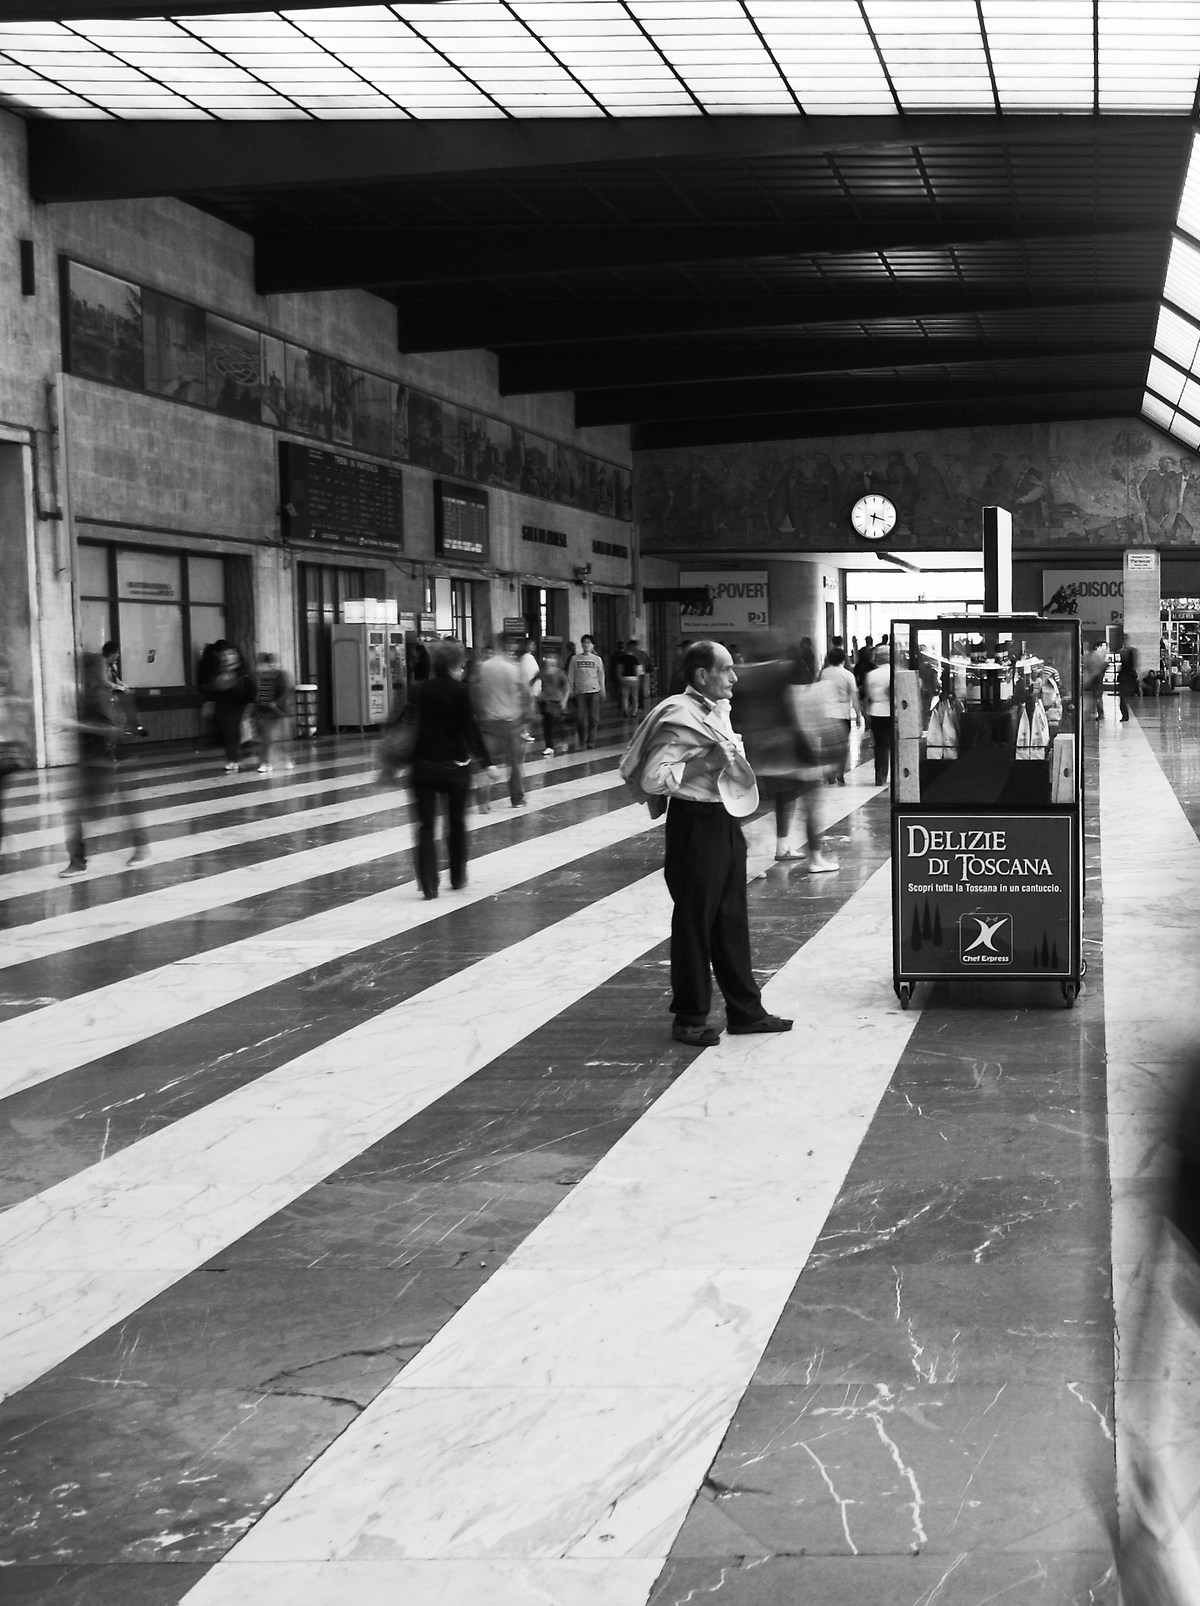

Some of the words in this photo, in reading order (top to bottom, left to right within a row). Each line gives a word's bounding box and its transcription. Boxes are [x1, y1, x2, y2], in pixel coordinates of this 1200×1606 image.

[907, 825, 1007, 857] DELIZIE
[928, 858, 949, 875] DI
[954, 854, 1053, 881] TOSCANA
[908, 883, 933, 894] Scopri
[935, 883, 953, 892] tutta
[955, 883, 963, 892] la
[965, 883, 998, 892] Toscana
[1000, 883, 1007, 892] in
[1009, 884, 1020, 892] un
[1021, 883, 1062, 892] cantuccio.
